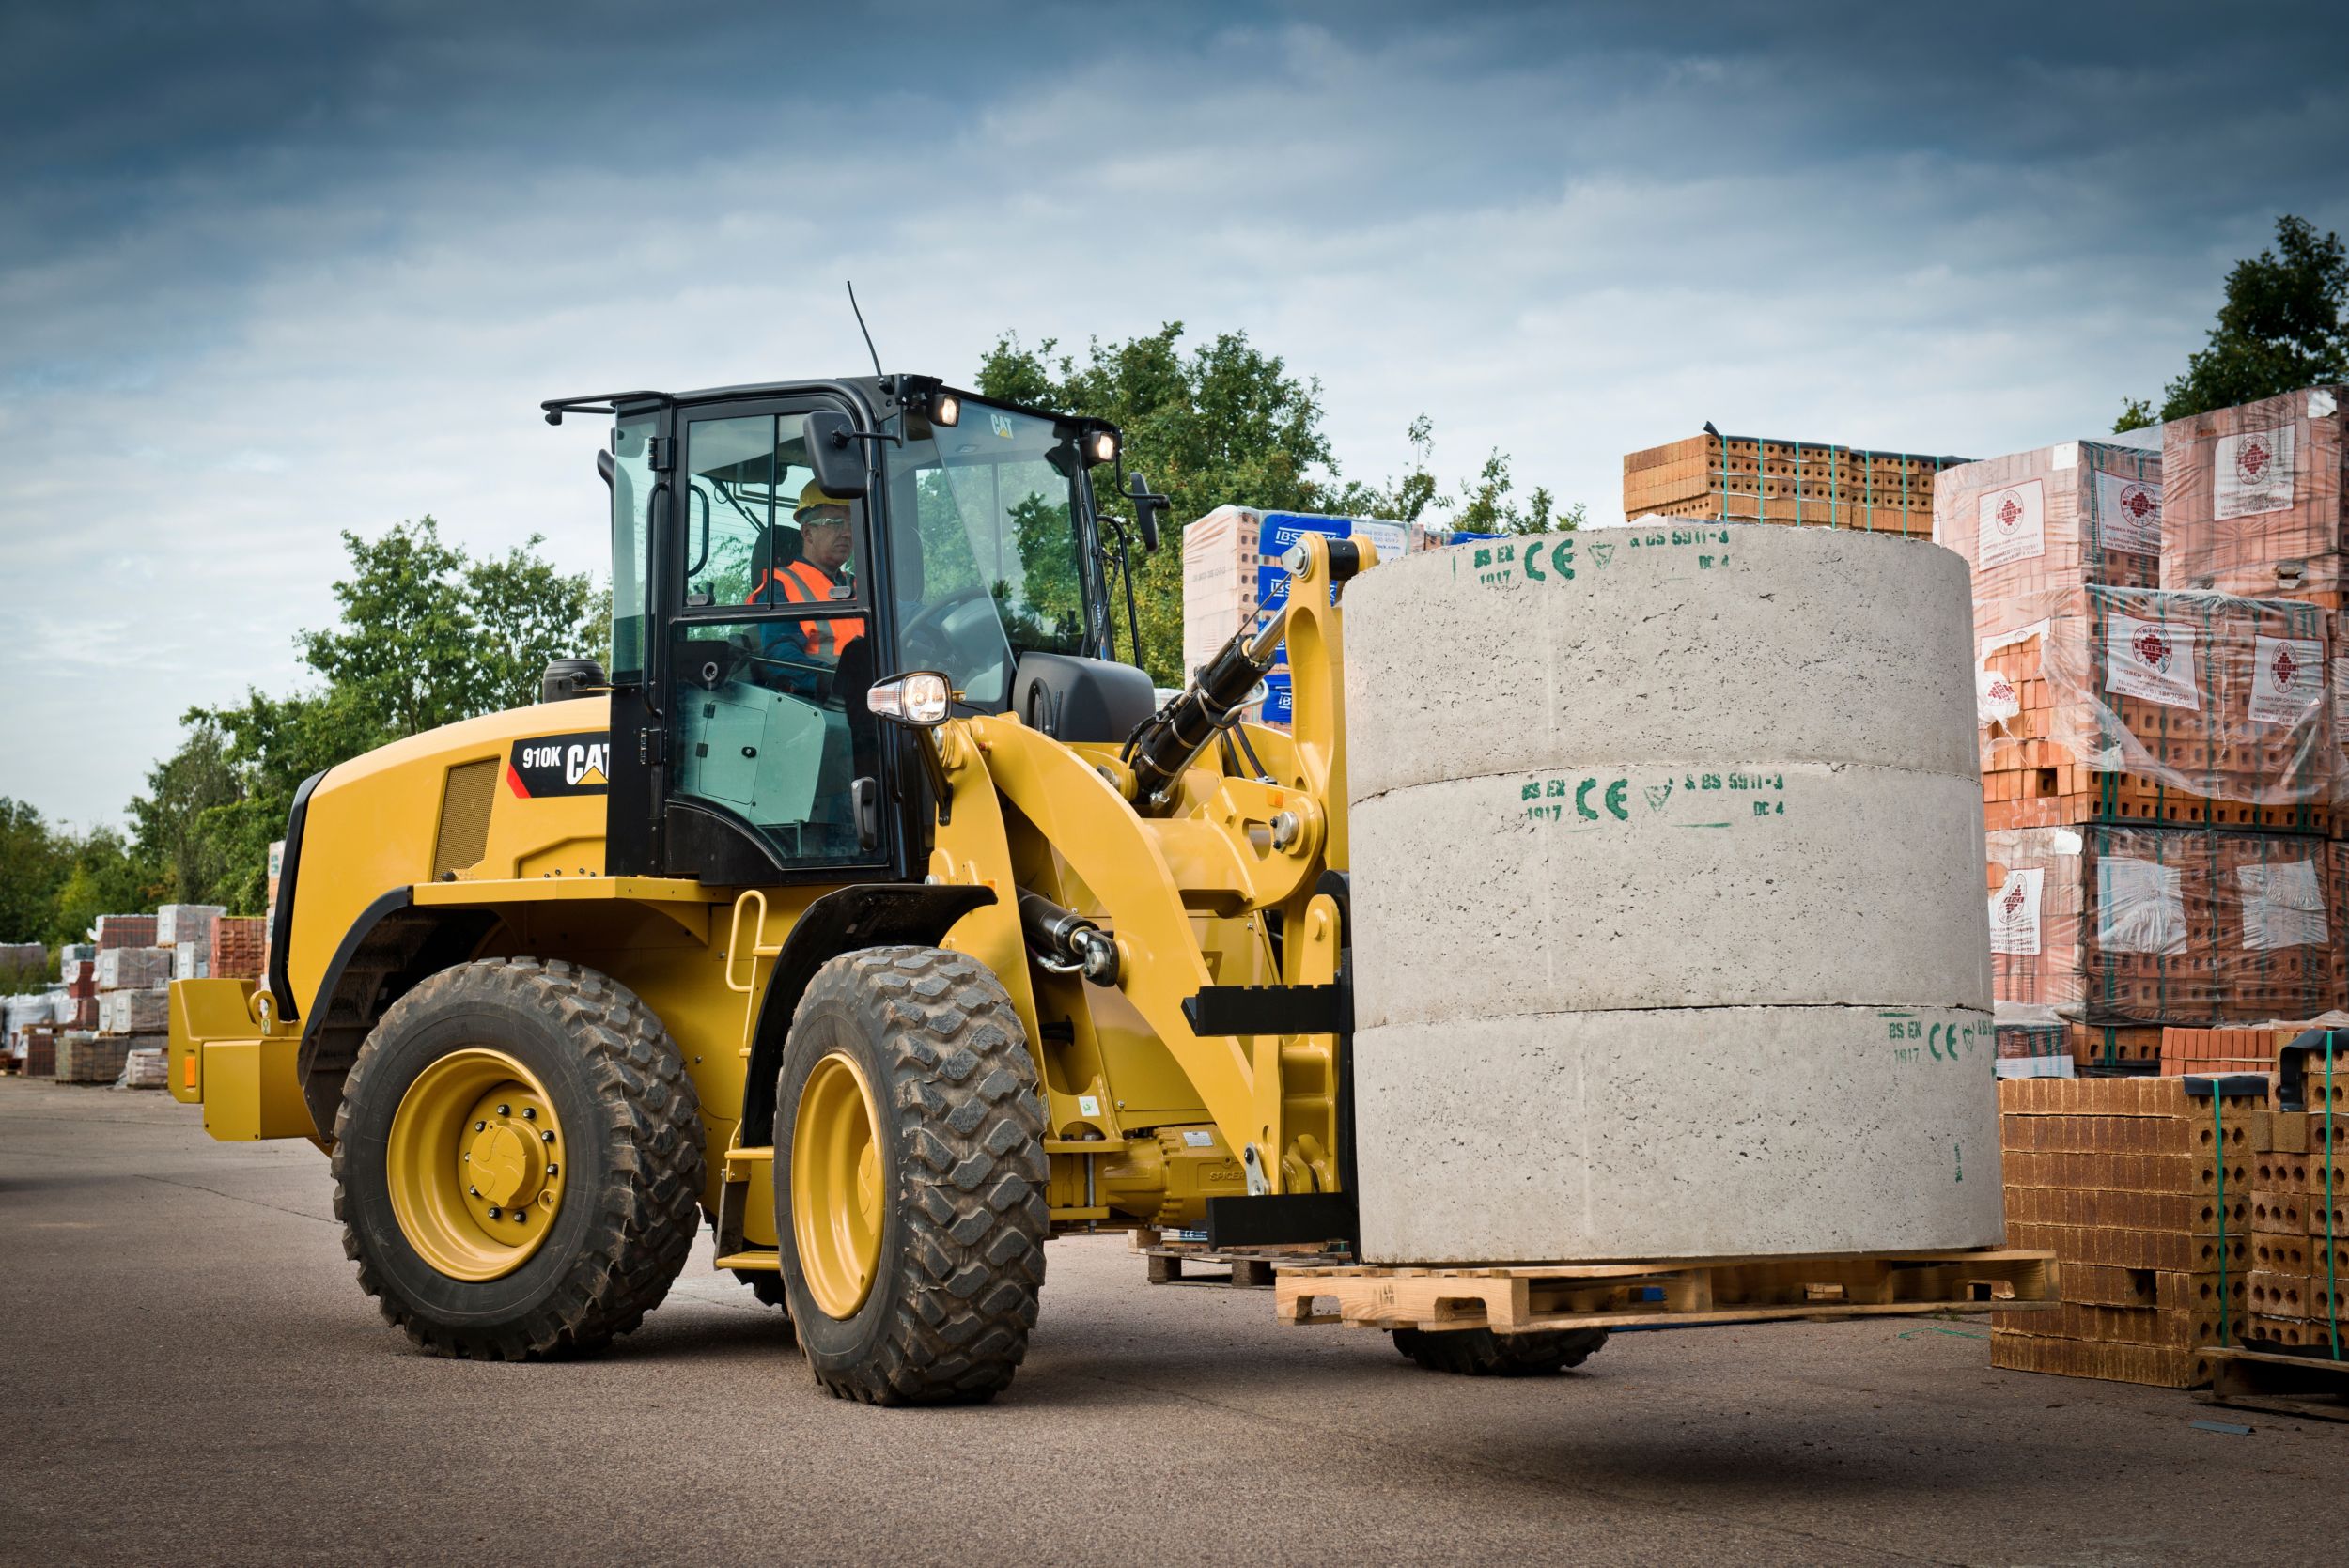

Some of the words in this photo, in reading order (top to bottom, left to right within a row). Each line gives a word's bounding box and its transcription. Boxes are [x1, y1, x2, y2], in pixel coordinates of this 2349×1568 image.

[990, 413, 1014, 440] CAT
[522, 746, 562, 768] 910K
[1701, 773, 1721, 790] BS
[1528, 805, 1562, 821] 1917
[1753, 801, 1769, 816] DC
[1775, 800, 1784, 815] 4
[1907, 1021, 1921, 1040] EN
[1209, 1171, 1245, 1182] SPICER
